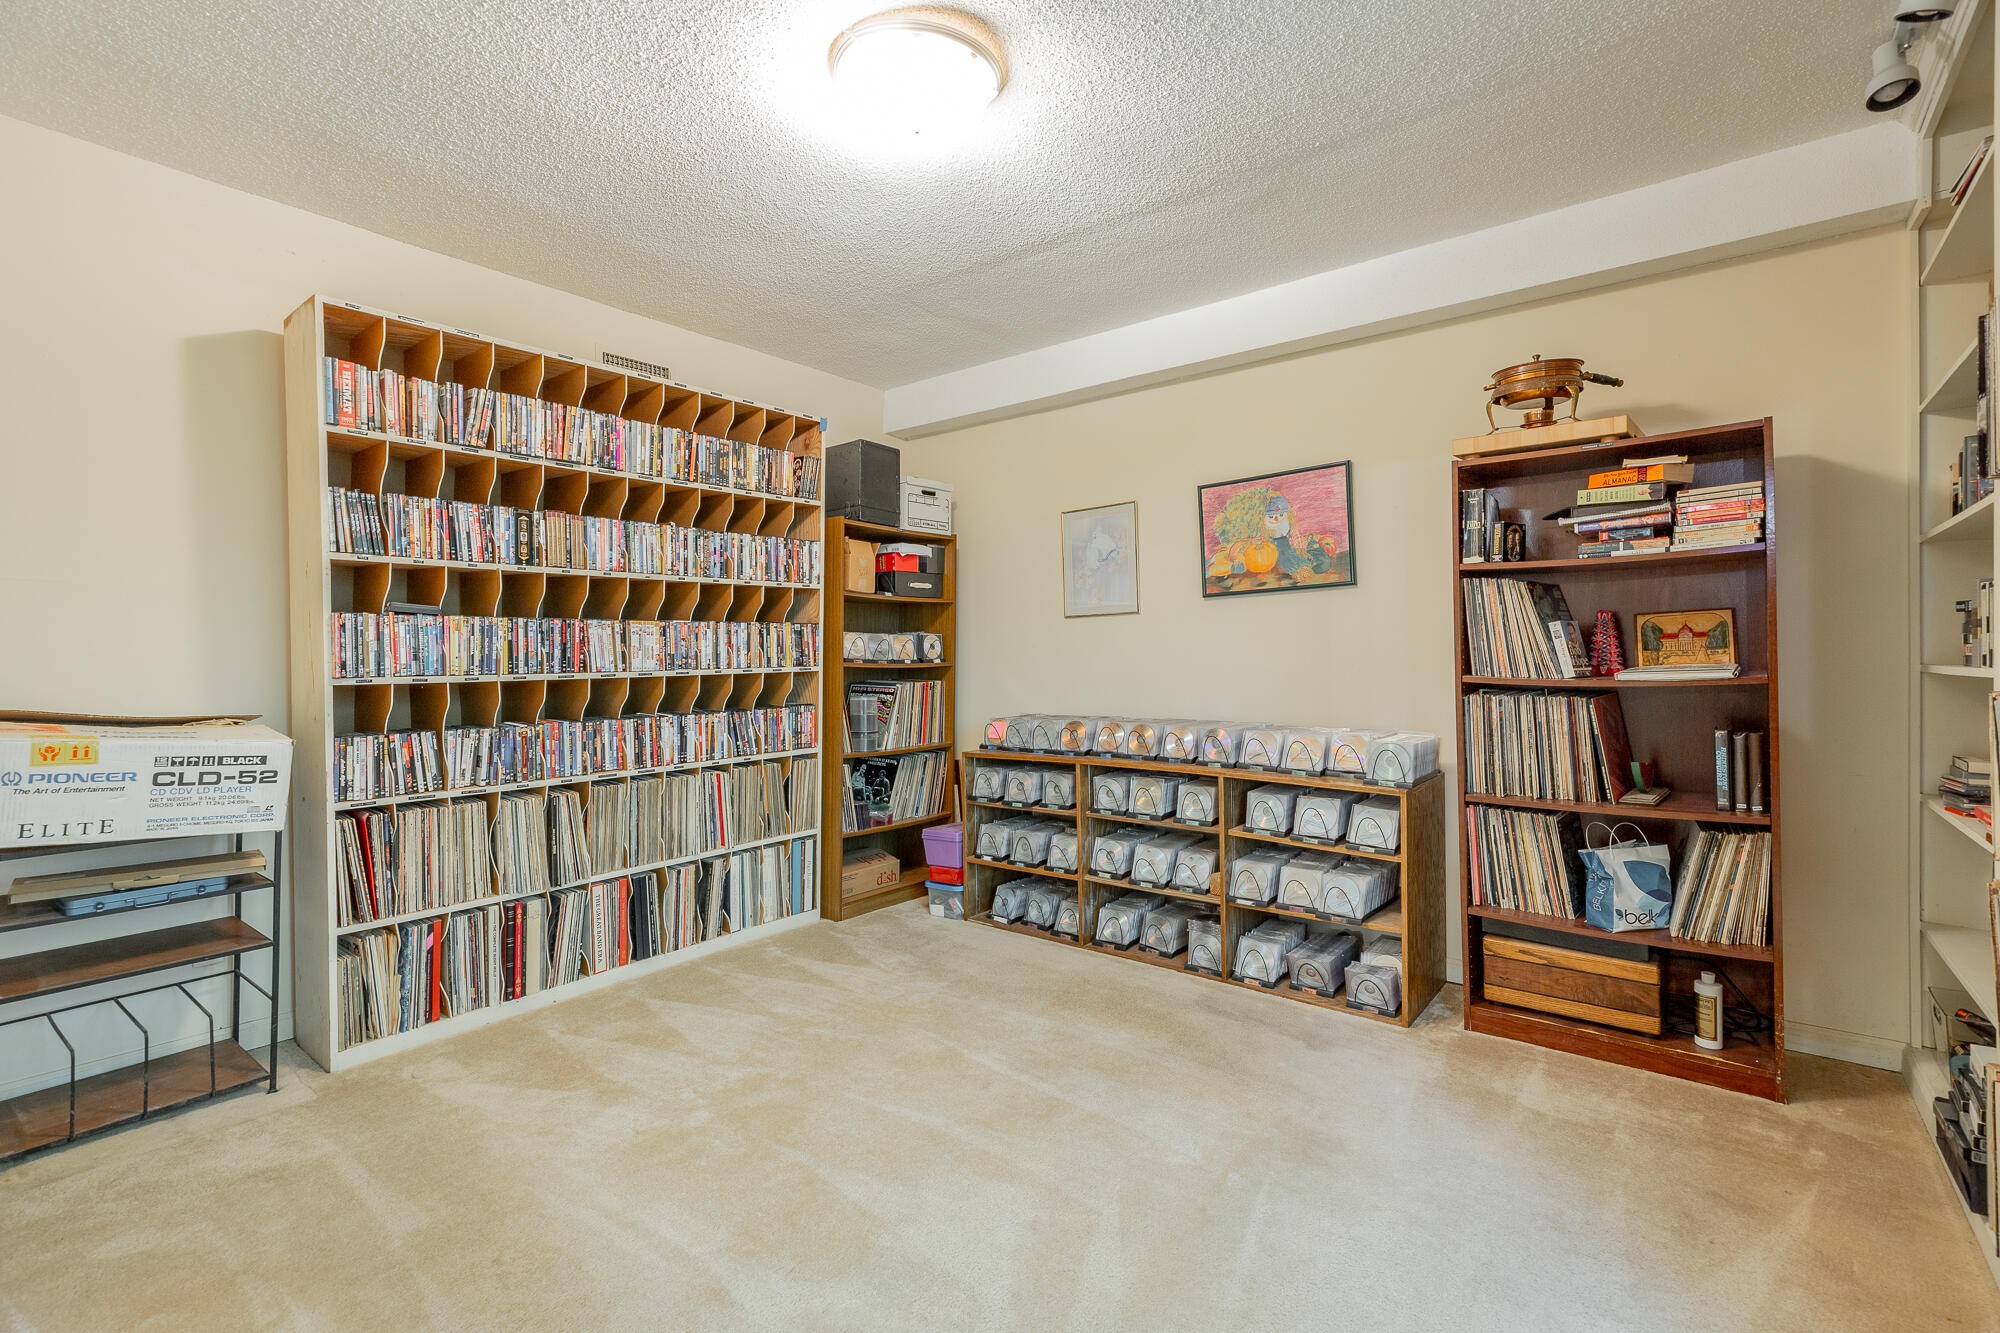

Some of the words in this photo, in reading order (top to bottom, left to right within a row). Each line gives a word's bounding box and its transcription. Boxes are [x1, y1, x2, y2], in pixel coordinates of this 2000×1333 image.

[1602, 475, 1637, 486] ALMANAC
[222, 757, 262, 765] BLACK
[28, 772, 138, 785] PIONEER
[152, 770, 279, 787] CLD-52
[63, 785, 126, 794] Entertainment
[150, 788, 167, 796] CD
[169, 787, 193, 796] CDV
[191, 814, 248, 822] ELECTRONIC
[17, 819, 115, 840] ELITE
[876, 869, 897, 886] dish
[1624, 909, 1659, 926] belk
